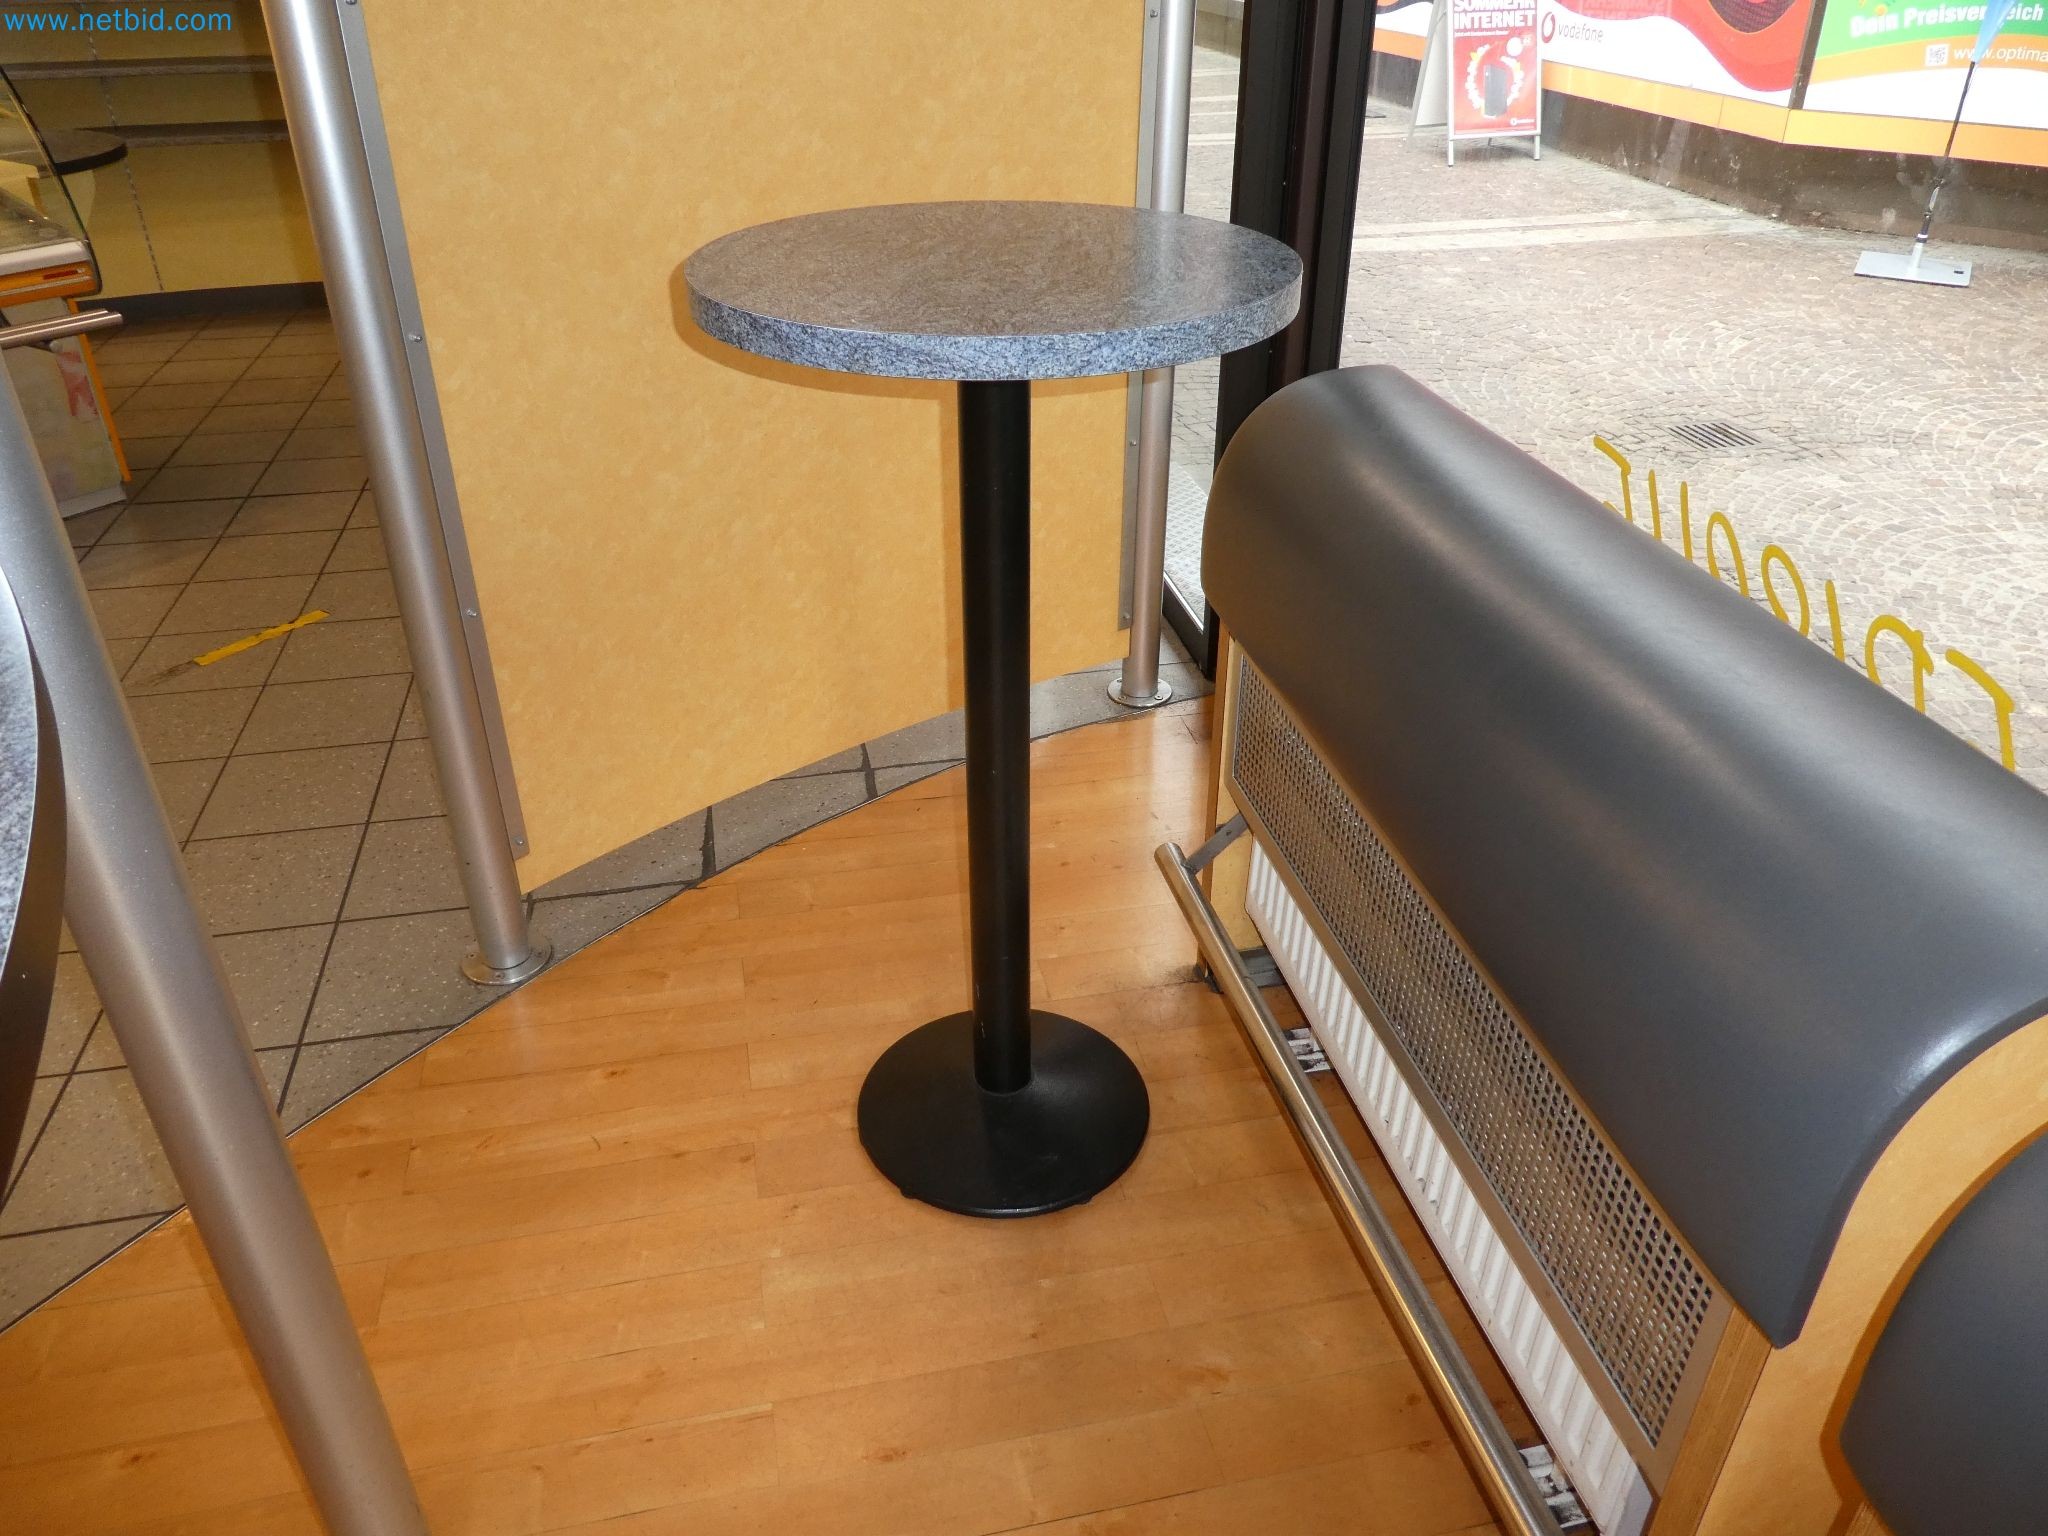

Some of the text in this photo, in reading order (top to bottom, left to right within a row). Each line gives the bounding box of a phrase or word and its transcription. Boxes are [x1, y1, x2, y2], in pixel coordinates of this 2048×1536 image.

[1454, 11, 1535, 28] INTERNET
[1903, 4, 2043, 27] Preisvereich
[1558, 22, 1605, 42] vodafone
